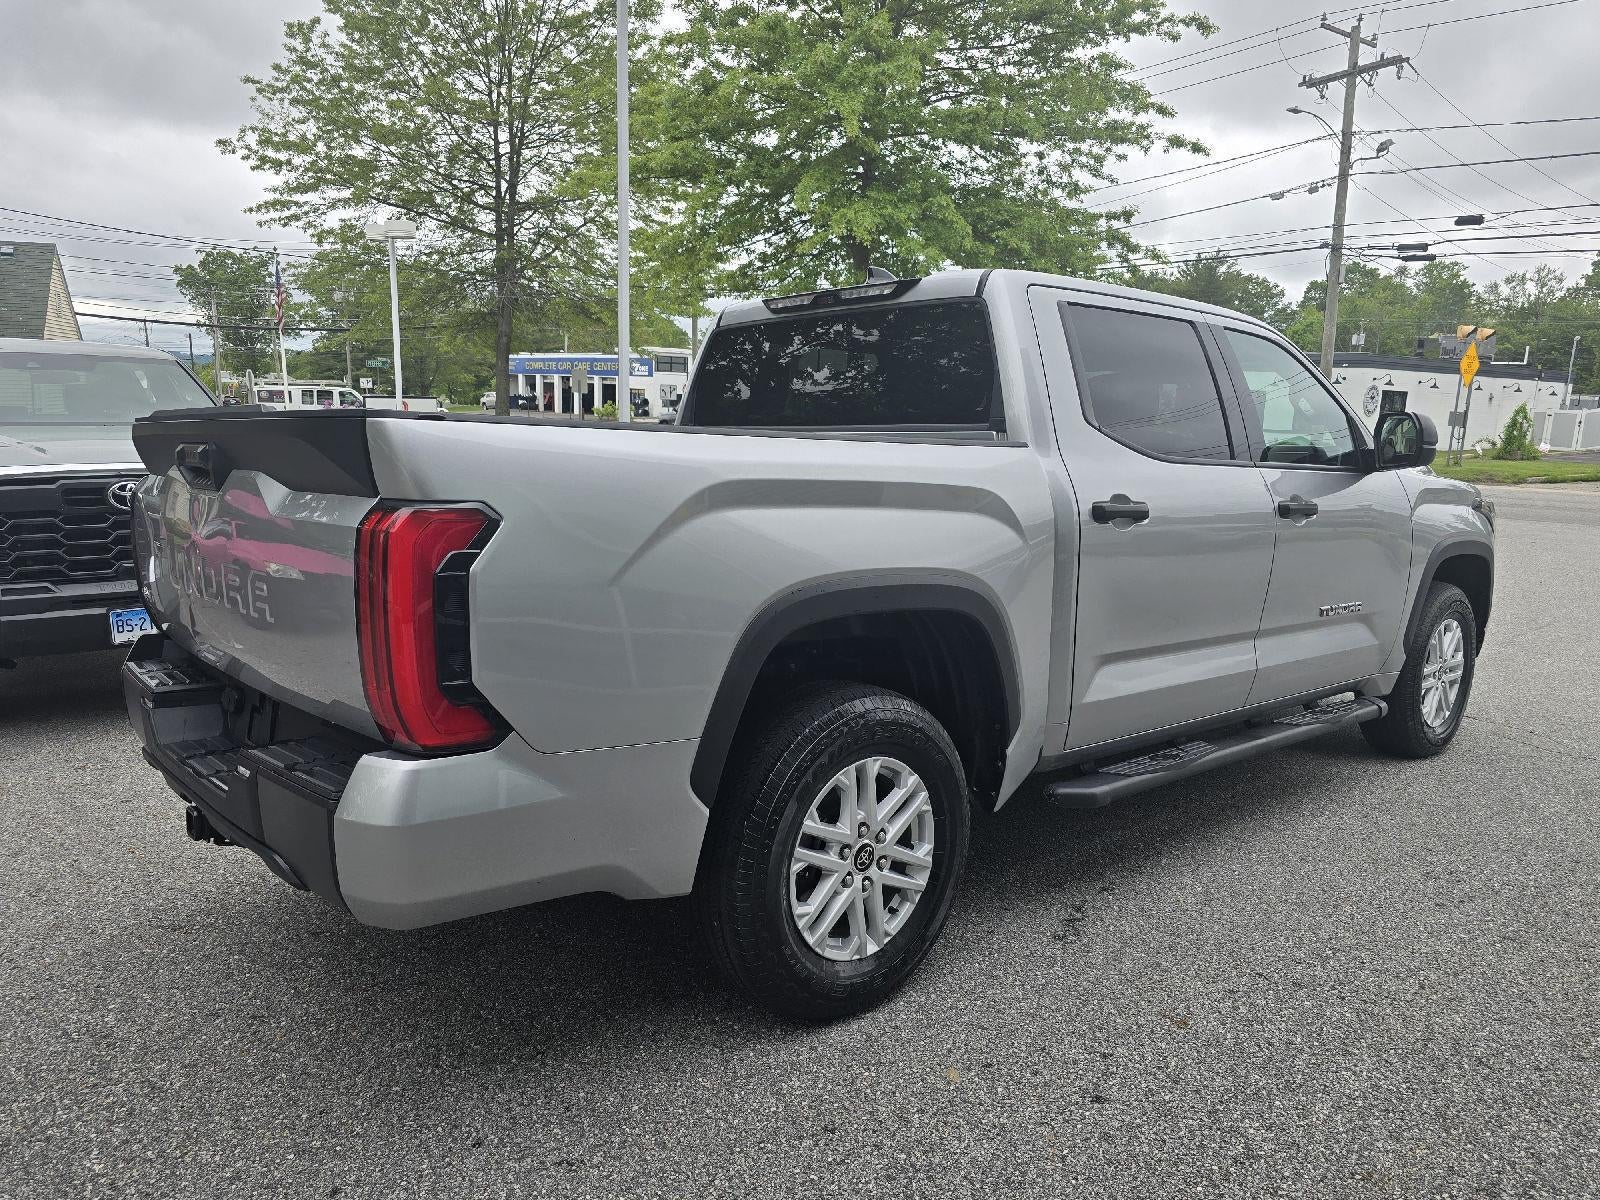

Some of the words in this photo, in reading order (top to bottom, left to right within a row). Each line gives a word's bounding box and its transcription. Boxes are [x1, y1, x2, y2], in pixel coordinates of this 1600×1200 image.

[525, 361, 557, 370] COMPLETE
[558, 361, 572, 370] CAR
[573, 361, 591, 371] CARE
[1319, 601, 1362, 617] TUNDRA
